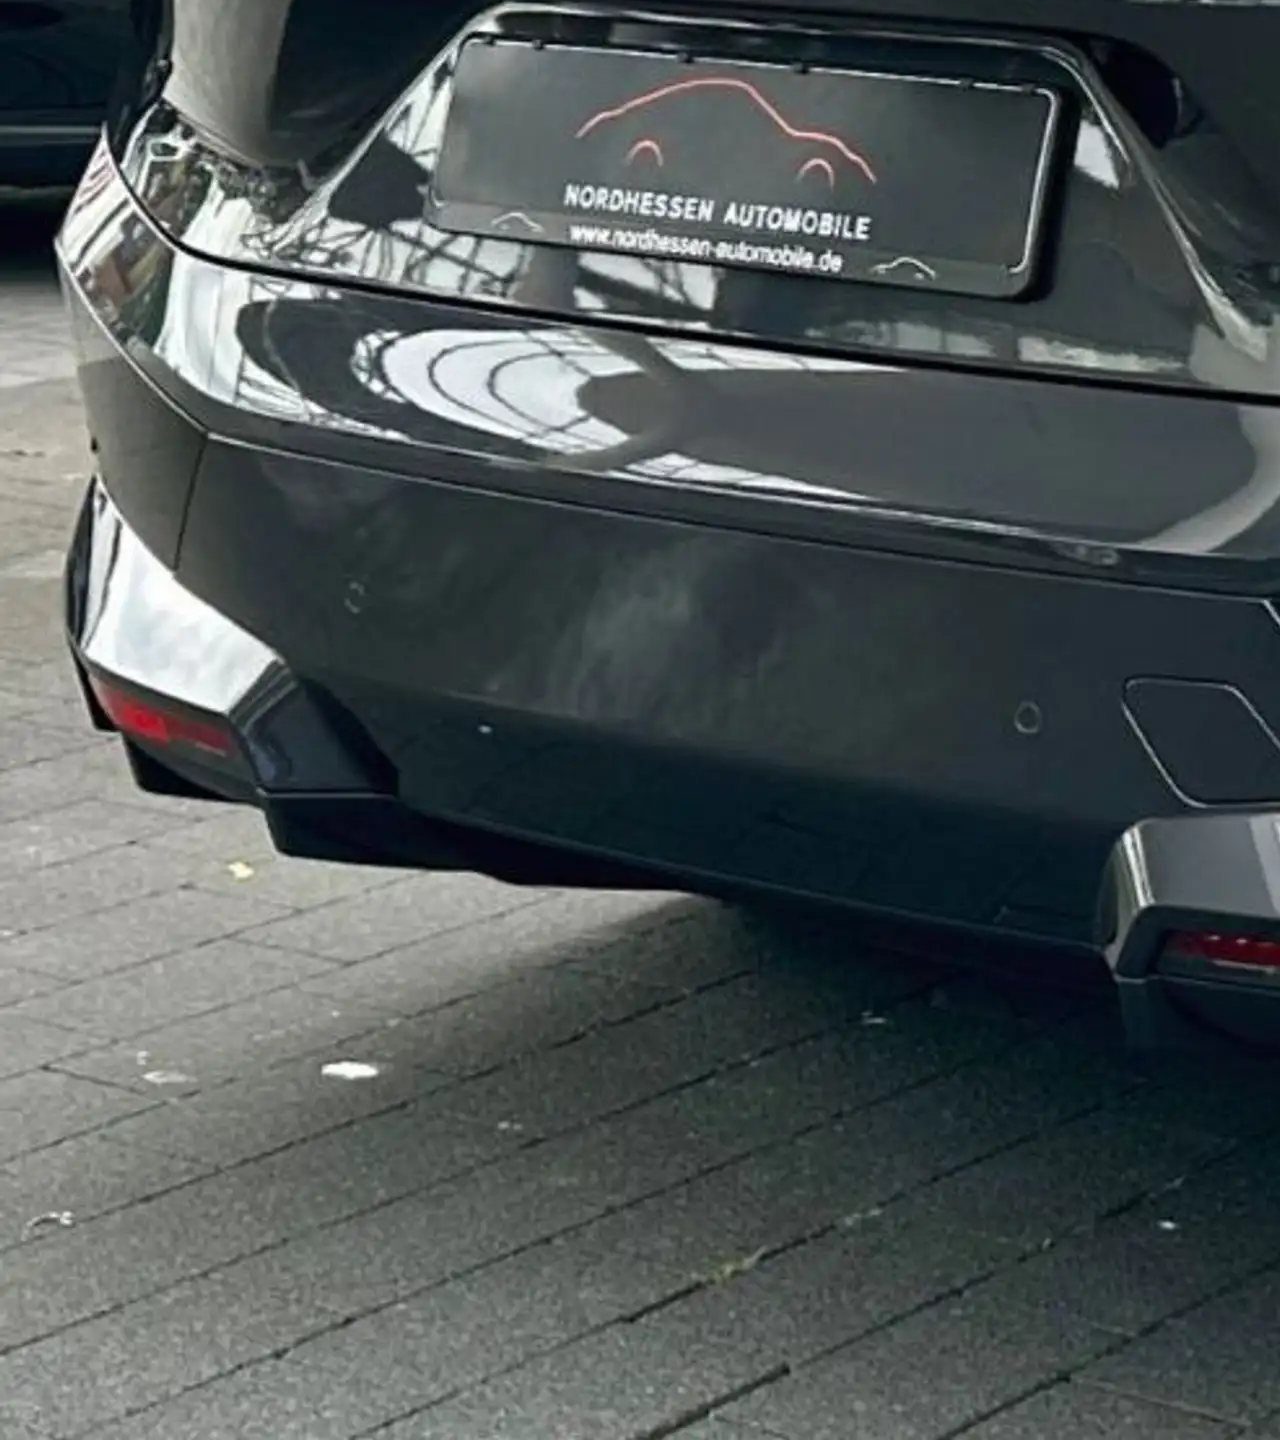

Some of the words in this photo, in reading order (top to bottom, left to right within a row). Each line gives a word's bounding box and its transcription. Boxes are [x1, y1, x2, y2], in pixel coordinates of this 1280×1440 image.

[564, 183, 715, 223] NORDHESSEN
[723, 201, 872, 241] AUTOMOBILE
[569, 225, 844, 274] www.nordhessen-automobile.de
